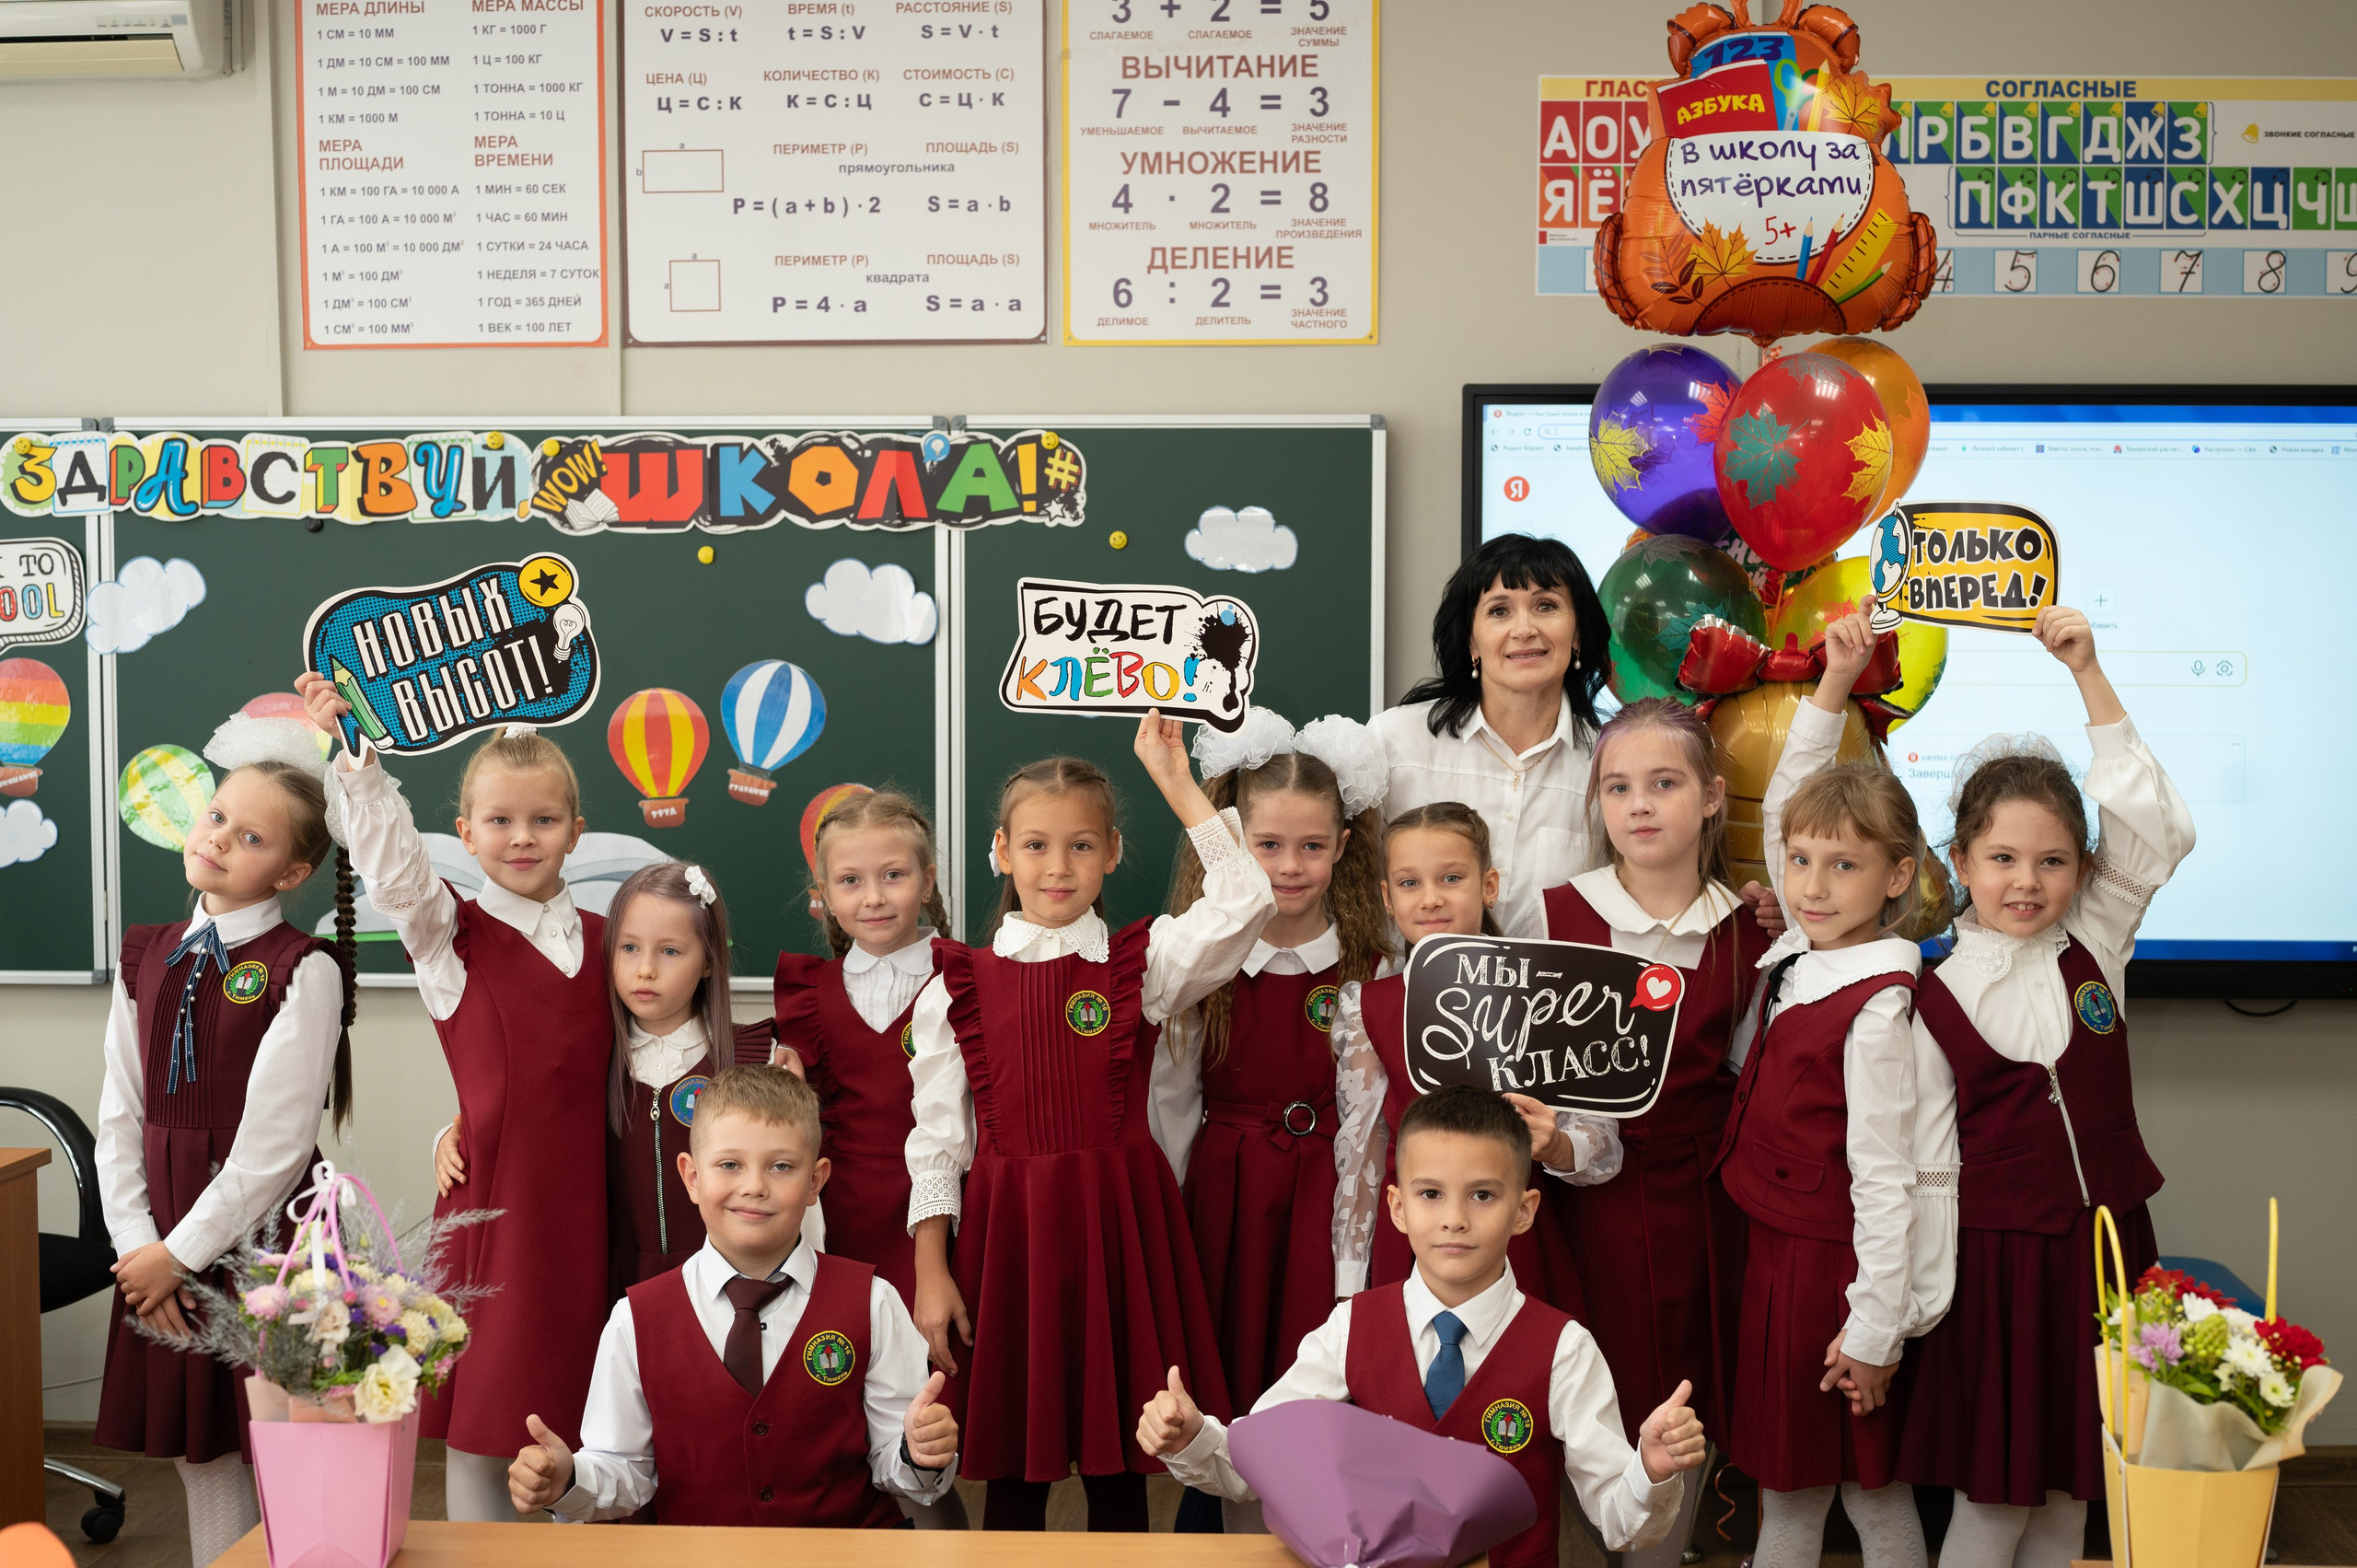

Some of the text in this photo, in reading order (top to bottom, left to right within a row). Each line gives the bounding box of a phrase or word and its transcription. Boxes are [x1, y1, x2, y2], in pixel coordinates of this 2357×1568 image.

[317, 1, 424, 17] МЕРА ДЛИНЫ
[472, 0, 583, 12] МЕРА МАССЫ
[645, 6, 742, 18] СКОРОСТЬ (V)
[788, 4, 854, 16] ВРЕМЯ (t)
[897, 1, 1012, 14] РАССТОЯНИЕ (S)
[1112, 0, 1329, 23] 3 2 5
[1090, 31, 1154, 40] СЛАГАЕМОЕ
[1189, 30, 1251, 39] СЛАГАЕМОЕ
[1292, 27, 1346, 35] ЗНАЧЕНИЕ
[1299, 39, 1339, 47] СУММЫ
[1704, 37, 1784, 69] 123
[1122, 54, 1318, 78] ВЫЧИТАНИЕ
[646, 73, 706, 86] ЦЕНА (Ц)
[764, 70, 858, 81] КОЛИЧЕСТВО
[904, 69, 991, 80] СТОИМОСТЬ
[474, 85, 478, 93] 1
[483, 84, 525, 93] ТОННА
[540, 83, 565, 92] 1000
[570, 83, 583, 91] КГ
[1585, 80, 1648, 99] ГЛАС
[1985, 80, 2137, 99] СОГЛАСНЫЕ
[1112, 87, 1329, 118] 7 4 3
[1677, 93, 1766, 125] АЗБУКА
[1081, 127, 1164, 135] УМЕНЬШАЕМОЕ
[1183, 126, 1257, 134] ВЫЧИТАЕМОЕ
[1292, 123, 1346, 132] ЗНАЧЕНИЕ
[475, 135, 517, 147] МЕРА
[1292, 134, 1347, 143] РАЗНОСТИ
[319, 140, 362, 152] МЕРА
[774, 144, 846, 154] ПЕРИМЕТР
[926, 143, 997, 154] ПЛОЩАДЬ
[475, 154, 552, 166] ВРЕМЕНИ
[1680, 140, 1861, 171] В школу за
[320, 157, 403, 171] ПЛОЩАДИ
[1120, 151, 1320, 174] УМНОЖЕНИЕ
[840, 164, 954, 175] прямоугольника
[1680, 173, 1862, 208] пятёрками
[1112, 182, 1329, 214] 4 2 8
[1089, 222, 1155, 230] МНОЖИТЕЛЬ
[1190, 221, 1256, 229] МНОЖИТЕЛЬ
[1292, 218, 1346, 226] ЗНАЧЕНИЕ
[1276, 230, 1362, 239] ПРОИЗВЕДЕНИЯ
[1765, 215, 1797, 245] 5+
[2029, 231, 2132, 240] ПАРНЫЕ СОГЛАСНЫЕ
[478, 242, 481, 250] 1
[487, 242, 524, 250] СУТКИ
[540, 241, 552, 250] 24
[556, 241, 588, 250] ЧАСА
[1147, 246, 1294, 273] ДЕЛЕНИЕ
[2004, 250, 2038, 293] 5
[2090, 250, 2121, 293] 6
[2174, 250, 2204, 293] 7
[2258, 250, 2286, 293] 8
[866, 274, 929, 285] квадрата
[1113, 277, 1329, 308] 6 2 3
[1292, 308, 1346, 317] ЗНАЧЕНИЕ
[479, 323, 482, 331] 1
[489, 323, 511, 332] ВЕК
[527, 323, 544, 331] 100
[549, 322, 571, 331] ЛЕТ
[1097, 318, 1148, 327] ДЕЛИМОЕ
[1195, 317, 1251, 326] ДЕЛИТЕЛЬ
[532, 438, 609, 513] WOW!
[598, 437, 1038, 523] ШКОЛА!
[1912, 527, 2043, 565] ТОЛЬКО
[19, 552, 54, 577] TO
[1909, 572, 2048, 610] ВПЕРЕД!
[0, 582, 65, 622] OOL
[1033, 597, 1188, 645] БУДЕТ
[354, 577, 513, 679] НОВЫХ
[1016, 647, 1201, 703] КЛЁВО!
[392, 634, 554, 742] ВЫСОТ!
[1422, 981, 1636, 1070] Super
[1485, 1034, 1652, 1092] КЛАСС!
[807, 1334, 836, 1361] ГИМНАЗИЯ
[822, 1371, 848, 1382] Тюмень
[1485, 1401, 1520, 1423] ГИМНАЗИЯ
[1495, 1441, 1522, 1451] Тюмень
